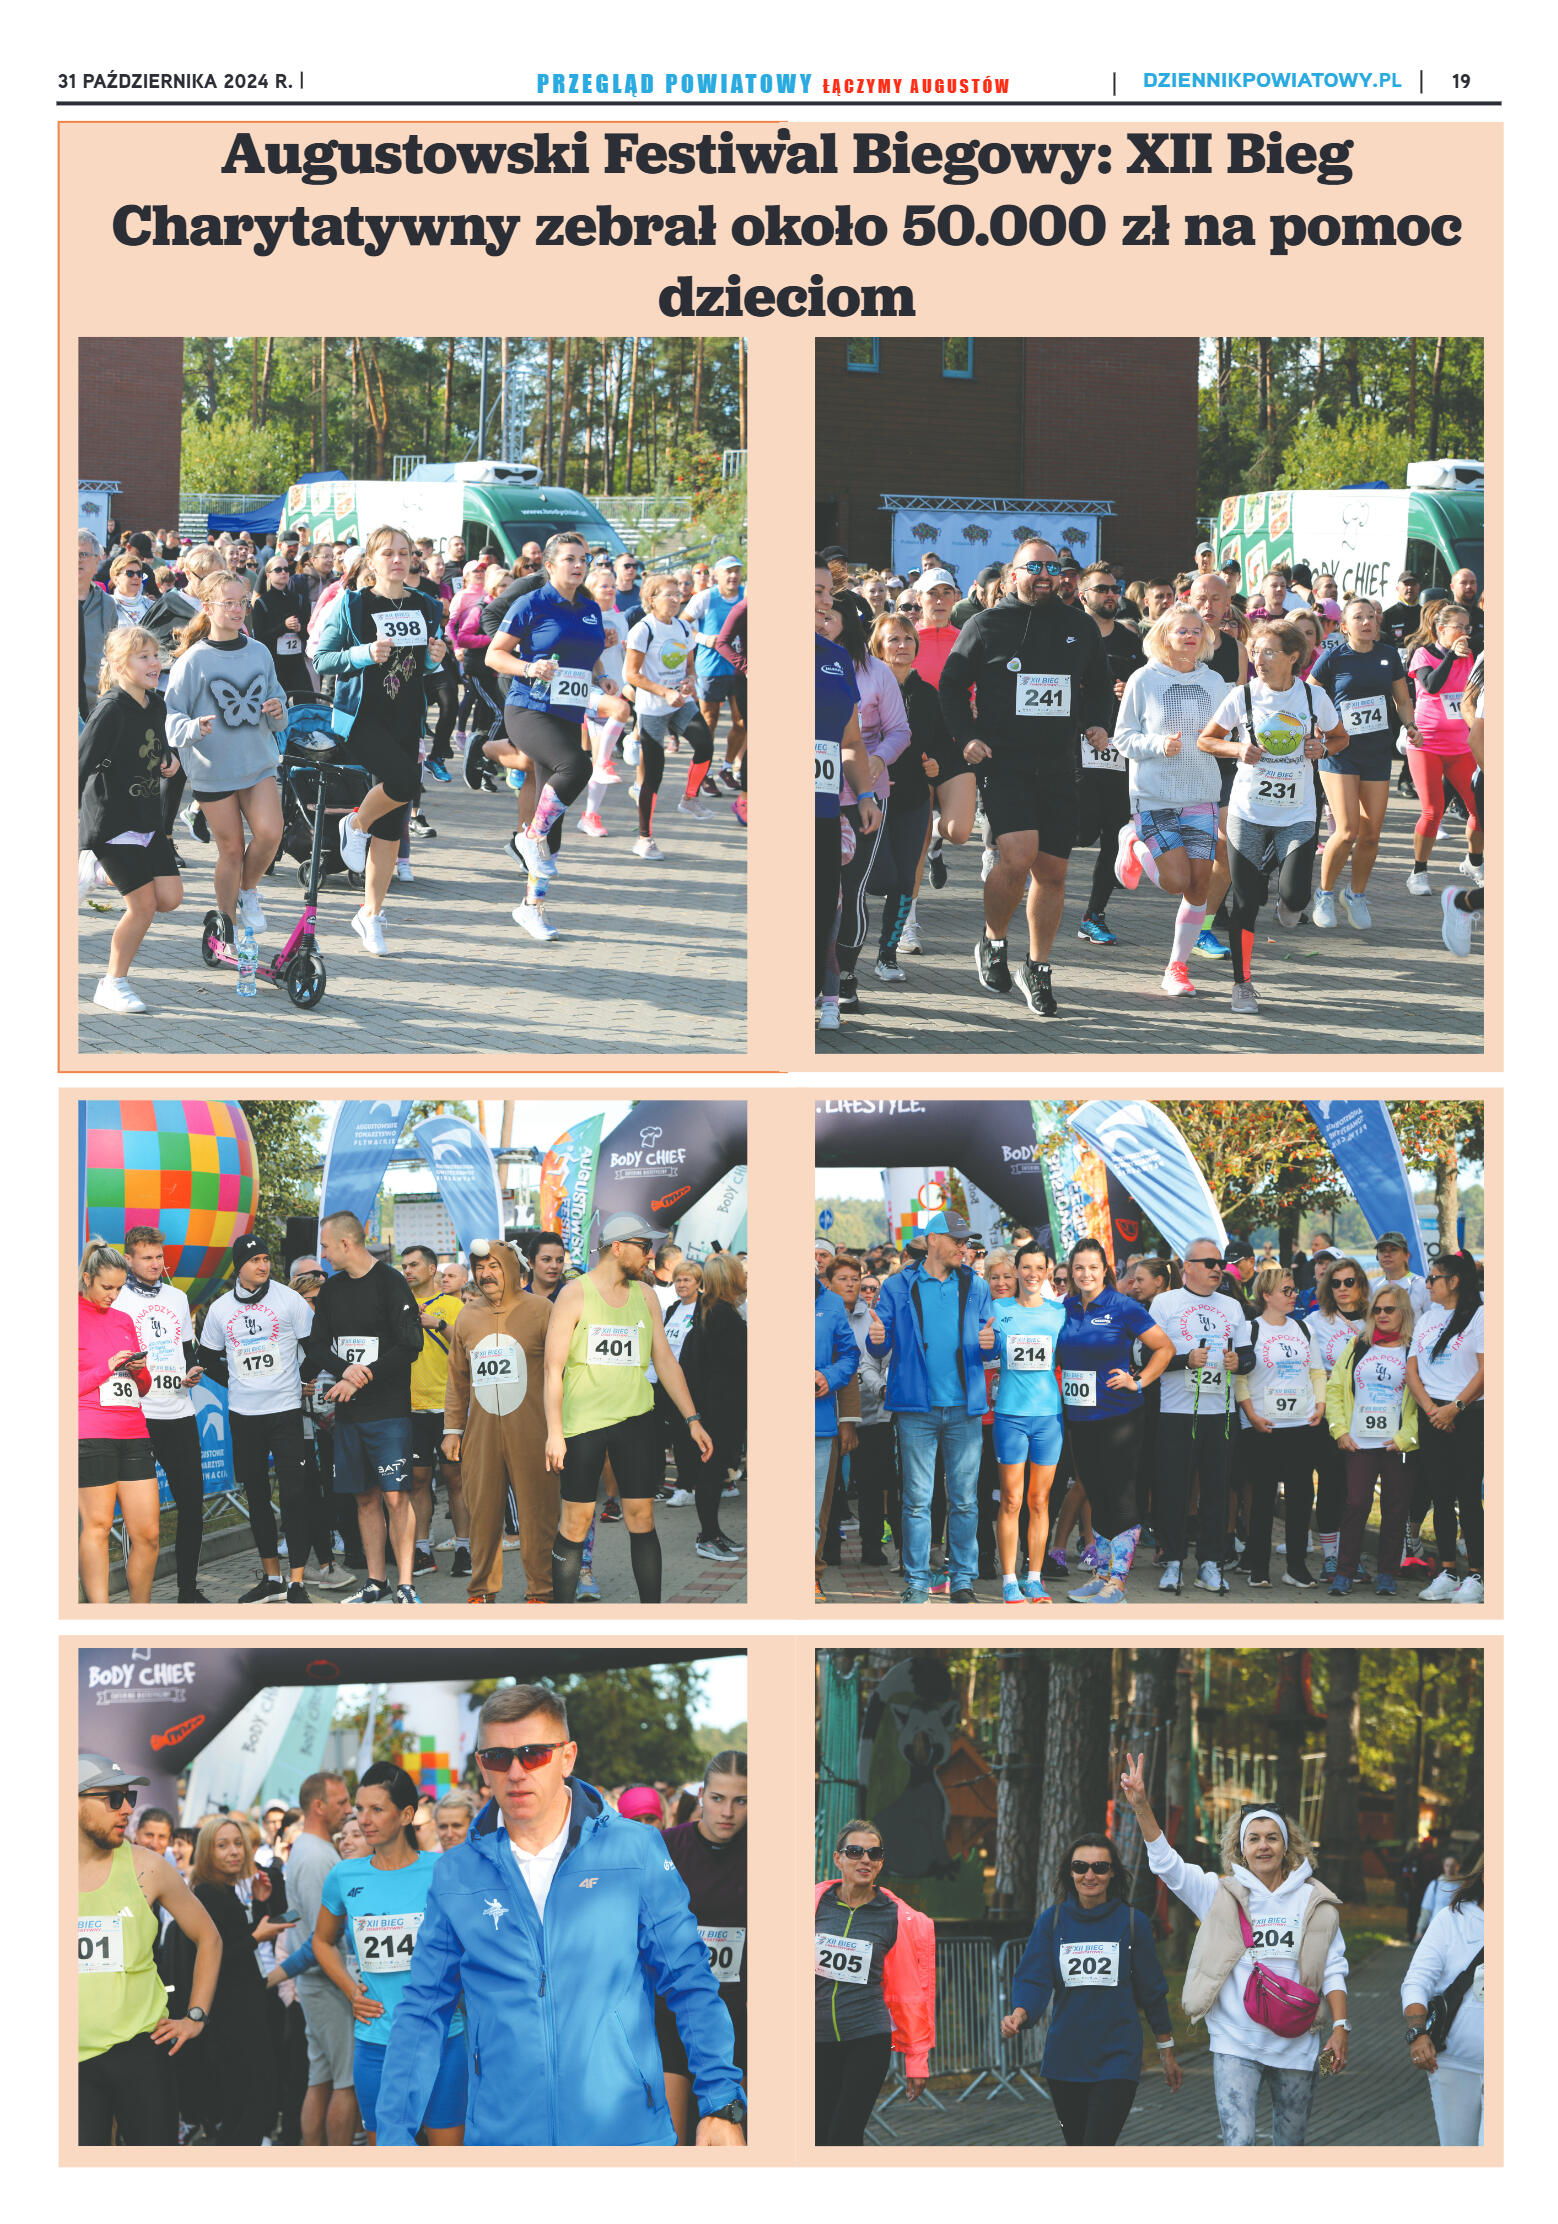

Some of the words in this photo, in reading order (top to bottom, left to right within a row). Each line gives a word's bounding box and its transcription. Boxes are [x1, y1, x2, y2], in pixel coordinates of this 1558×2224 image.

[57, 74, 76, 89] 31
[82, 70, 218, 89] PAŹDZIERNIKA
[223, 73, 269, 89] 2024
[275, 73, 293, 89] R.
[537, 73, 654, 98] PRZEGLĄD
[665, 73, 813, 94] POWIATOWY
[822, 78, 903, 97] ŁĄCZYMY
[909, 75, 1010, 94] AUGUSTÓW
[1143, 72, 1403, 88] DZIENNIKPOWIATOWY.PL
[1451, 73, 1471, 89] 19
[221, 131, 589, 186] Augustowski
[603, 131, 839, 175] Festiwal
[852, 131, 1112, 186] Biegowy:
[1125, 133, 1213, 175] XII
[1226, 131, 1355, 186] Bieg
[112, 203, 521, 258] Charytatywny
[535, 203, 718, 247] zebrał
[730, 203, 889, 247] około
[902, 203, 1108, 248] 50.000
[1121, 203, 1171, 247] zł
[1184, 213, 1257, 247] na
[1269, 213, 1463, 256] pomoc
[658, 273, 917, 318] dzieciom
[384, 620, 421, 637] 398
[286, 639, 298, 649] 12
[558, 680, 588, 698] 200
[1024, 689, 1063, 707] 241
[1350, 708, 1382, 726] 374
[1090, 748, 1120, 763] 187
[1258, 780, 1297, 799] 231
[609, 1150, 644, 1168] BODY
[645, 1147, 687, 1166] CHIEF
[570, 1145, 594, 1265] AUGUSTOWSKI
[346, 1348, 366, 1363] 67
[595, 1339, 632, 1357] 401
[1013, 1347, 1046, 1362] 214
[242, 1353, 274, 1371] 179
[476, 1359, 512, 1377] 402
[153, 1375, 182, 1390] 180
[1190, 1370, 1222, 1386] 324
[112, 1381, 133, 1398] 36
[1064, 1382, 1090, 1398] 200
[1275, 1398, 1297, 1412] 97
[1365, 1415, 1388, 1430] 98
[88, 1663, 135, 1689] BODY
[138, 1660, 197, 1687] CHIEF
[78, 1920, 103, 1929] BIEG
[366, 1919, 379, 1928] XII
[380, 1918, 404, 1927] BIEG
[707, 1930, 729, 1938] BIEG
[826, 1937, 837, 1945] XII
[837, 1939, 857, 1949] BIEG
[1251, 1929, 1295, 1949] 204
[78, 1936, 110, 1960] 01
[363, 1933, 415, 1959] 214
[819, 1949, 863, 1974] 205
[1067, 1957, 1112, 1976] 202
